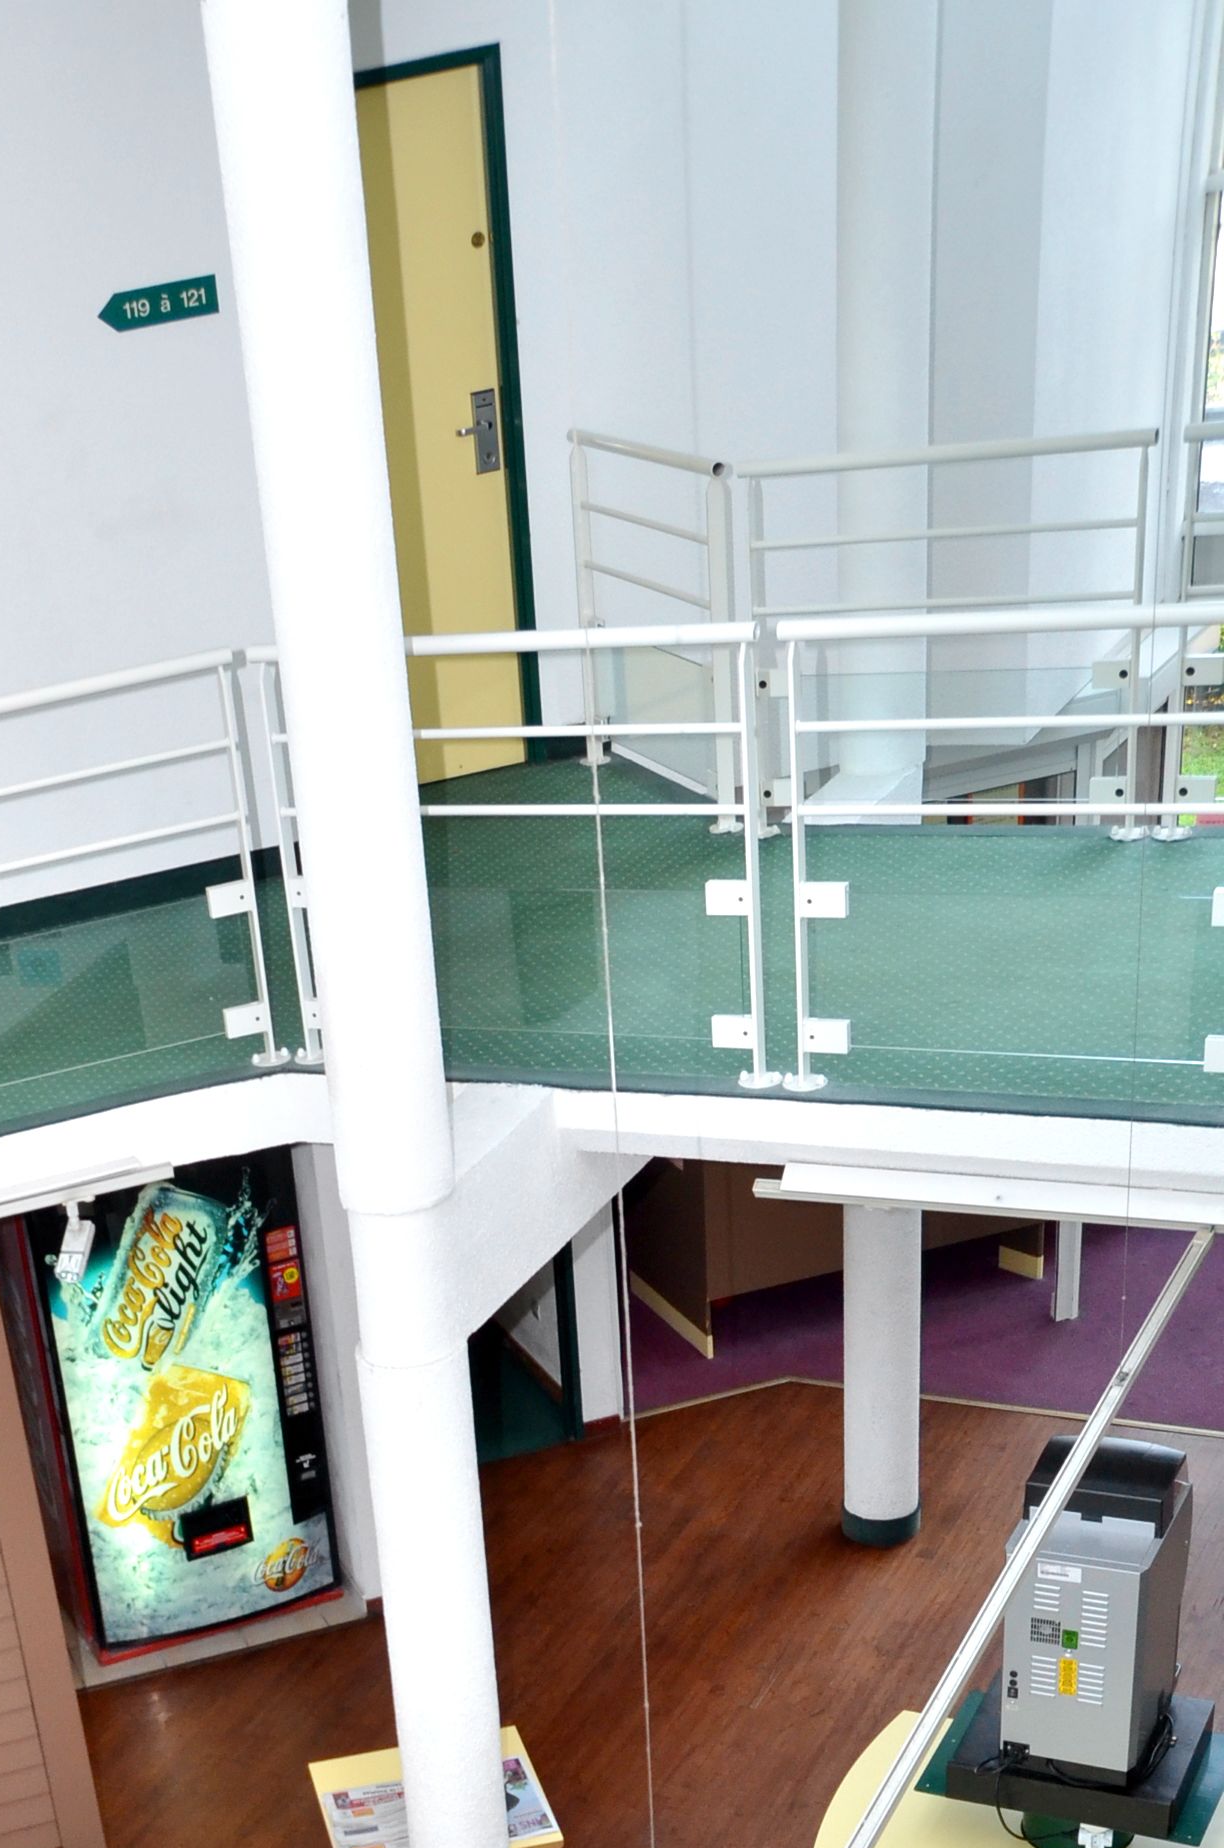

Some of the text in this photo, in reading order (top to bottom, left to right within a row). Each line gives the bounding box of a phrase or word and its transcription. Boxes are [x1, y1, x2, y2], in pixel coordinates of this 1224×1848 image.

[122, 287, 207, 320] 119 à 121
[153, 1219, 208, 1331] light
